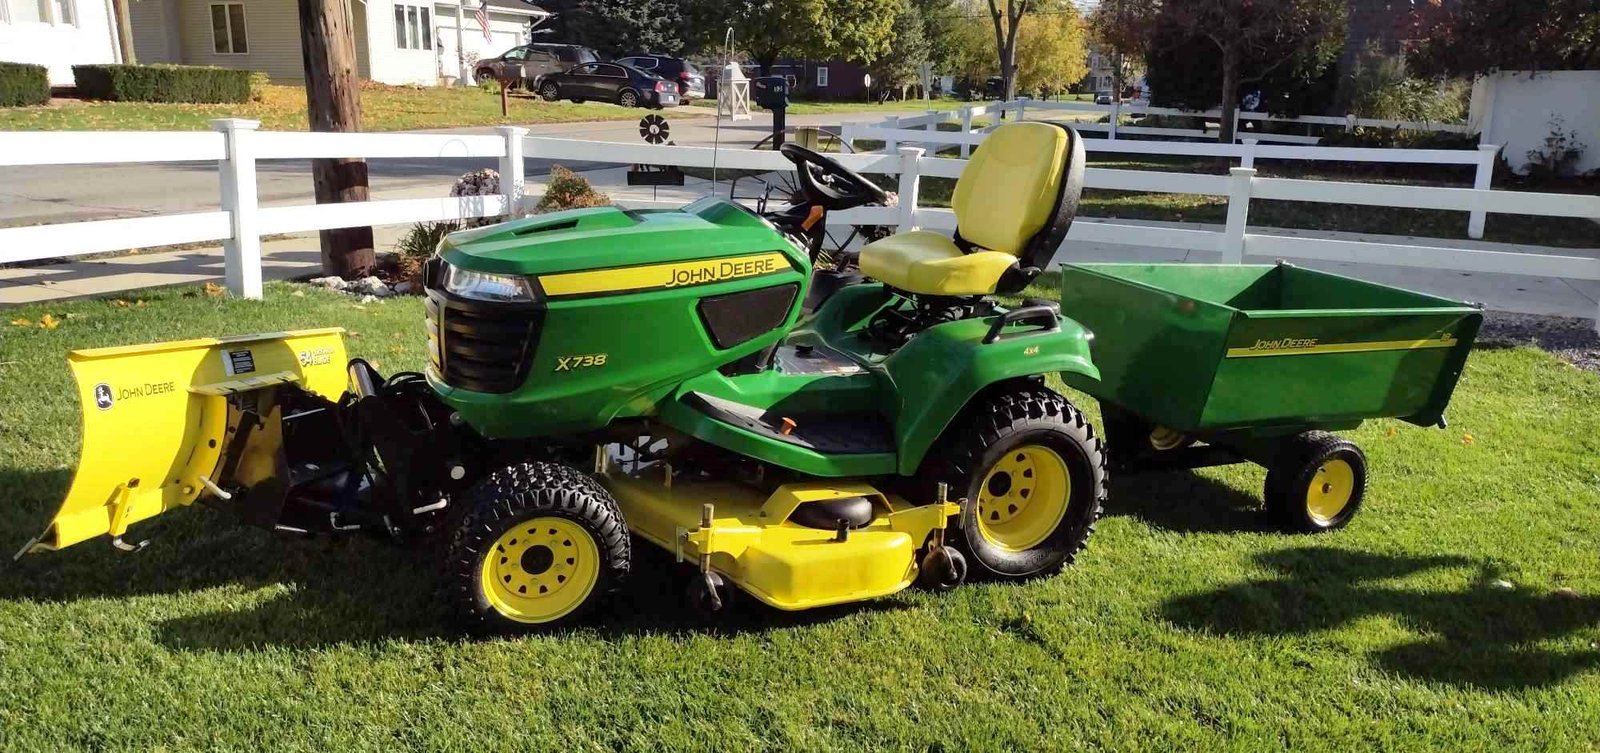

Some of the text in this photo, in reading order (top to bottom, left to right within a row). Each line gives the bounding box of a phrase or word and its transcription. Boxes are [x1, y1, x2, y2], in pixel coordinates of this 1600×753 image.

[665, 258, 775, 286] JOHN DEERE
[1249, 338, 1319, 351] JOHN DEERE
[554, 354, 607, 372] X738
[117, 381, 176, 401] JOHN DEERE
